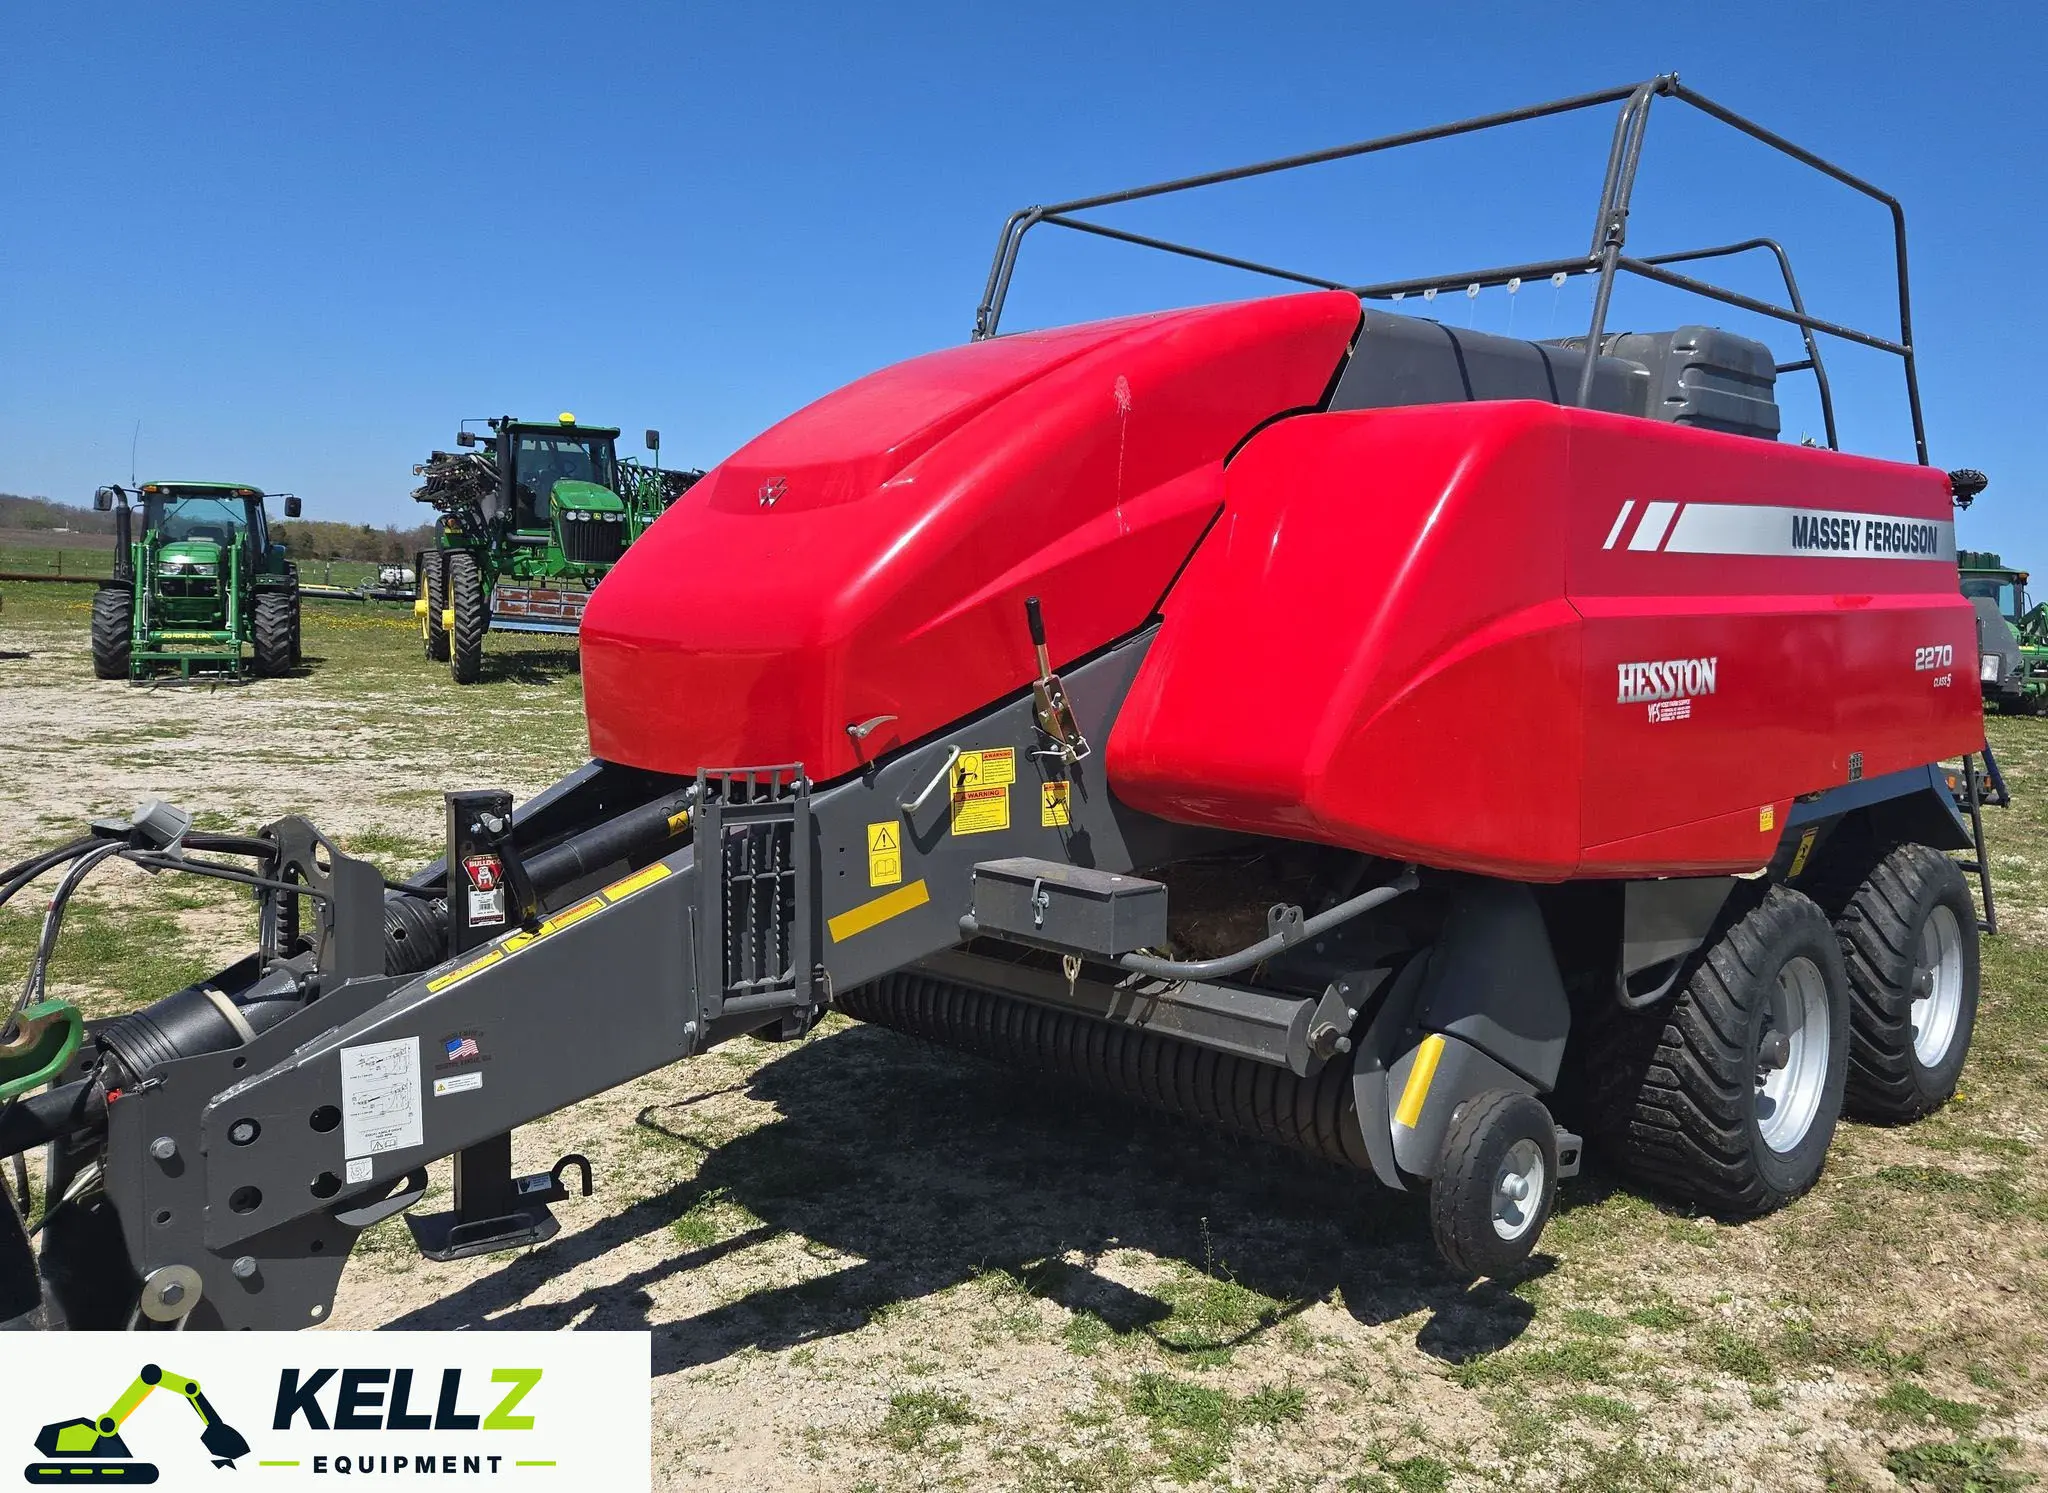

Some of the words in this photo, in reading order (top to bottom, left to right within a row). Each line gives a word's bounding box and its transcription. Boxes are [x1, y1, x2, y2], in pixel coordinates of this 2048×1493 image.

[1792, 515, 1861, 551] MASSEY
[1865, 520, 1938, 554] FERGUSON
[1915, 644, 1953, 671] 2270
[1617, 657, 1718, 704] HESSTON
[1648, 702, 1661, 724] YFS
[988, 751, 1011, 760] WARNING
[968, 789, 1000, 799] WARNING
